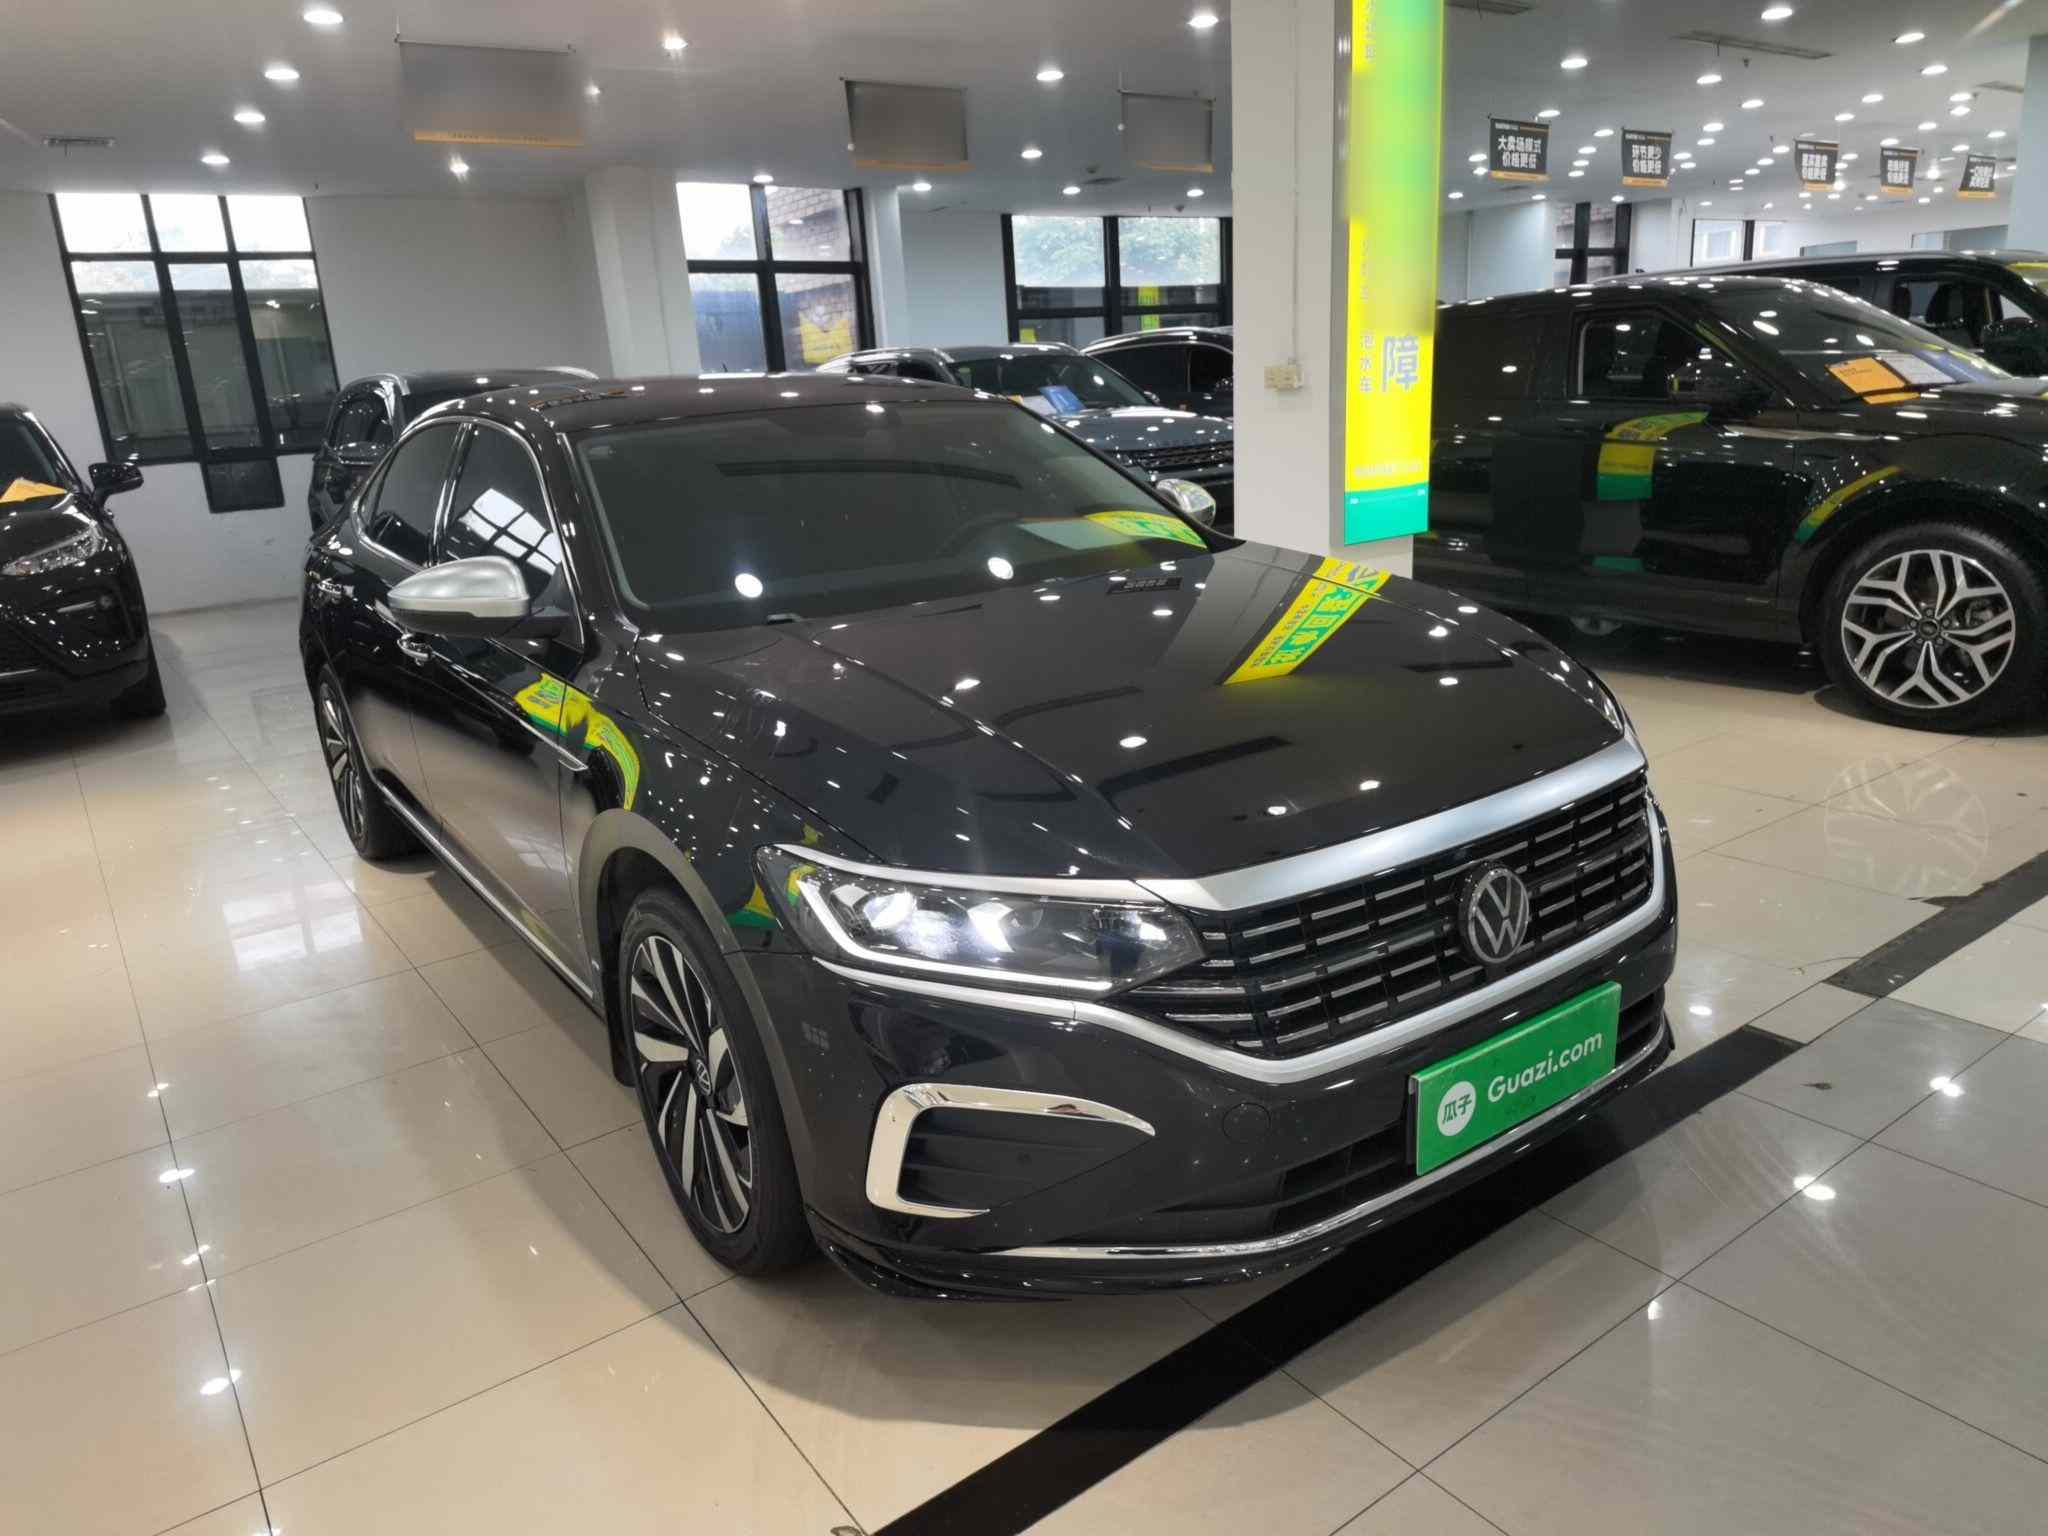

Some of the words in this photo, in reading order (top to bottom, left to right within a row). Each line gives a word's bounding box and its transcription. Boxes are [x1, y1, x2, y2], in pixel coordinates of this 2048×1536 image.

[1498, 135, 1542, 154] 大卖场模式
[1502, 151, 1537, 169] 价格更低
[1381, 335, 1419, 392] 障
[1487, 1032, 1603, 1103] Guazi.com
[1442, 1093, 1473, 1125] 瓜子
